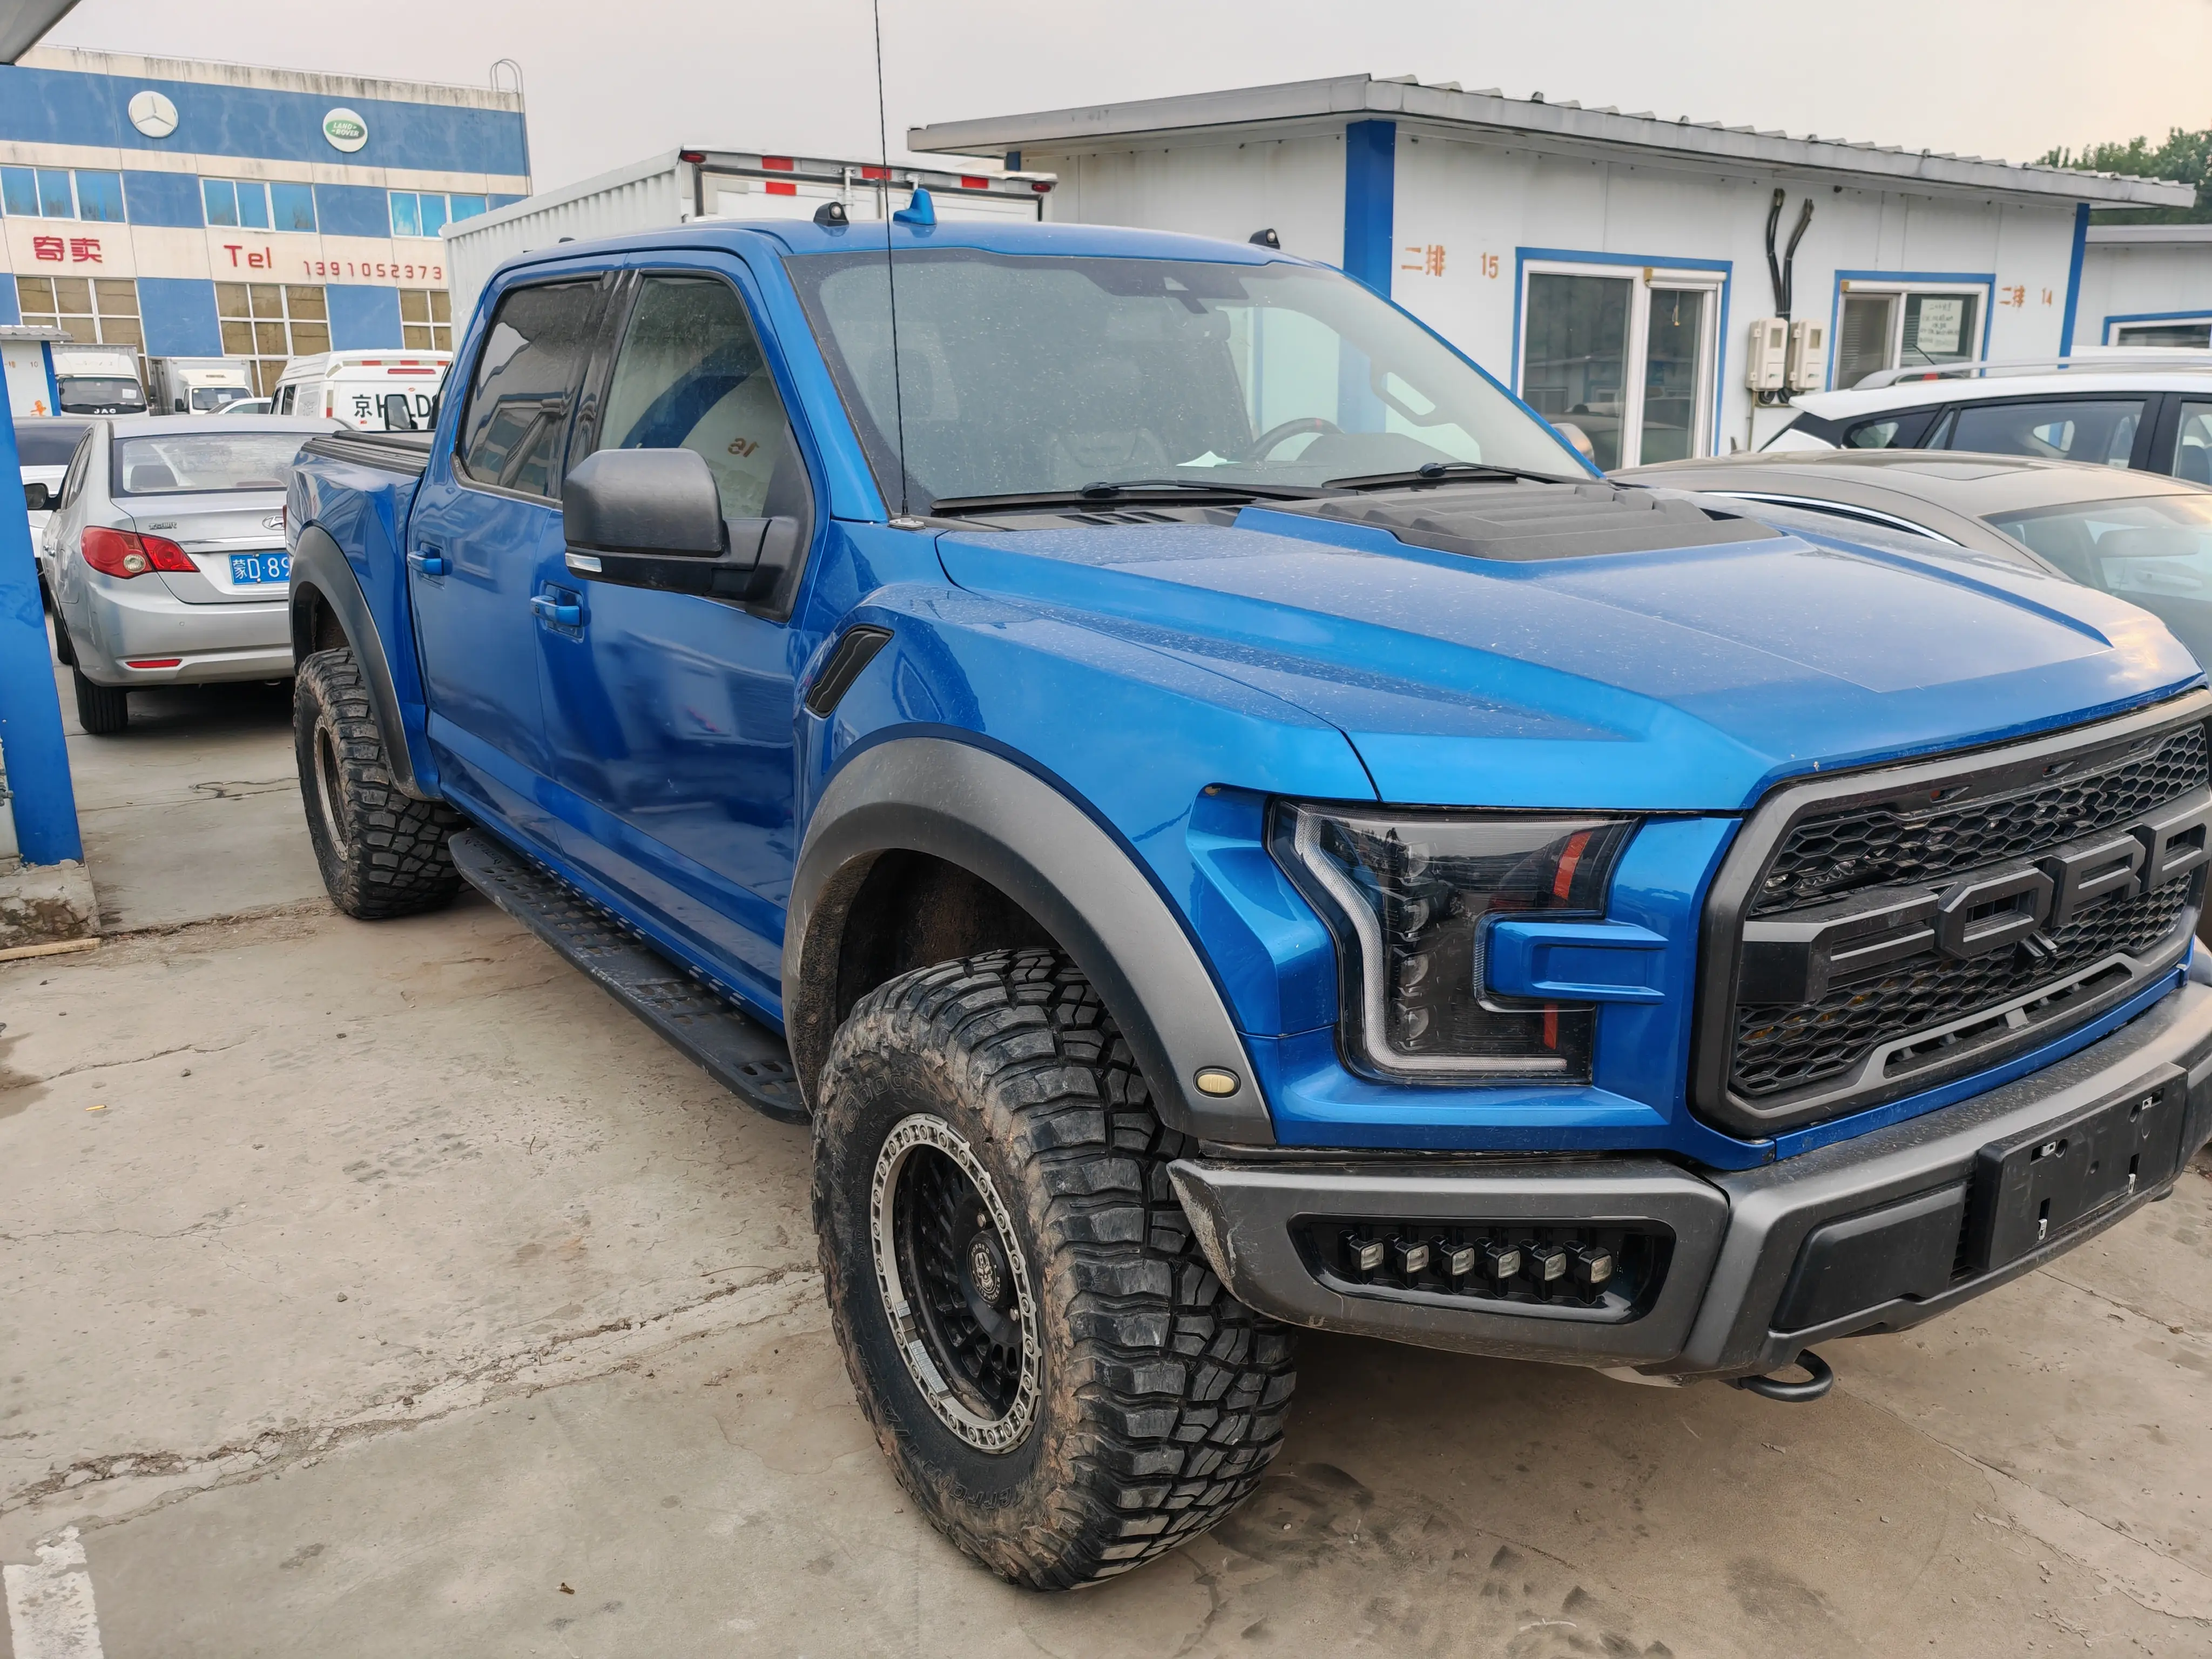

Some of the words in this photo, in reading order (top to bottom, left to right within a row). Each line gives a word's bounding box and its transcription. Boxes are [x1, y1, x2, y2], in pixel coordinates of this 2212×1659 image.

[335, 129, 359, 137] ROVER
[224, 245, 272, 268] Tel
[303, 261, 442, 280] 1391052373
[1401, 245, 1446, 277] 二排
[1480, 252, 1499, 279] 15
[1803, 799, 2211, 1004] FORD
